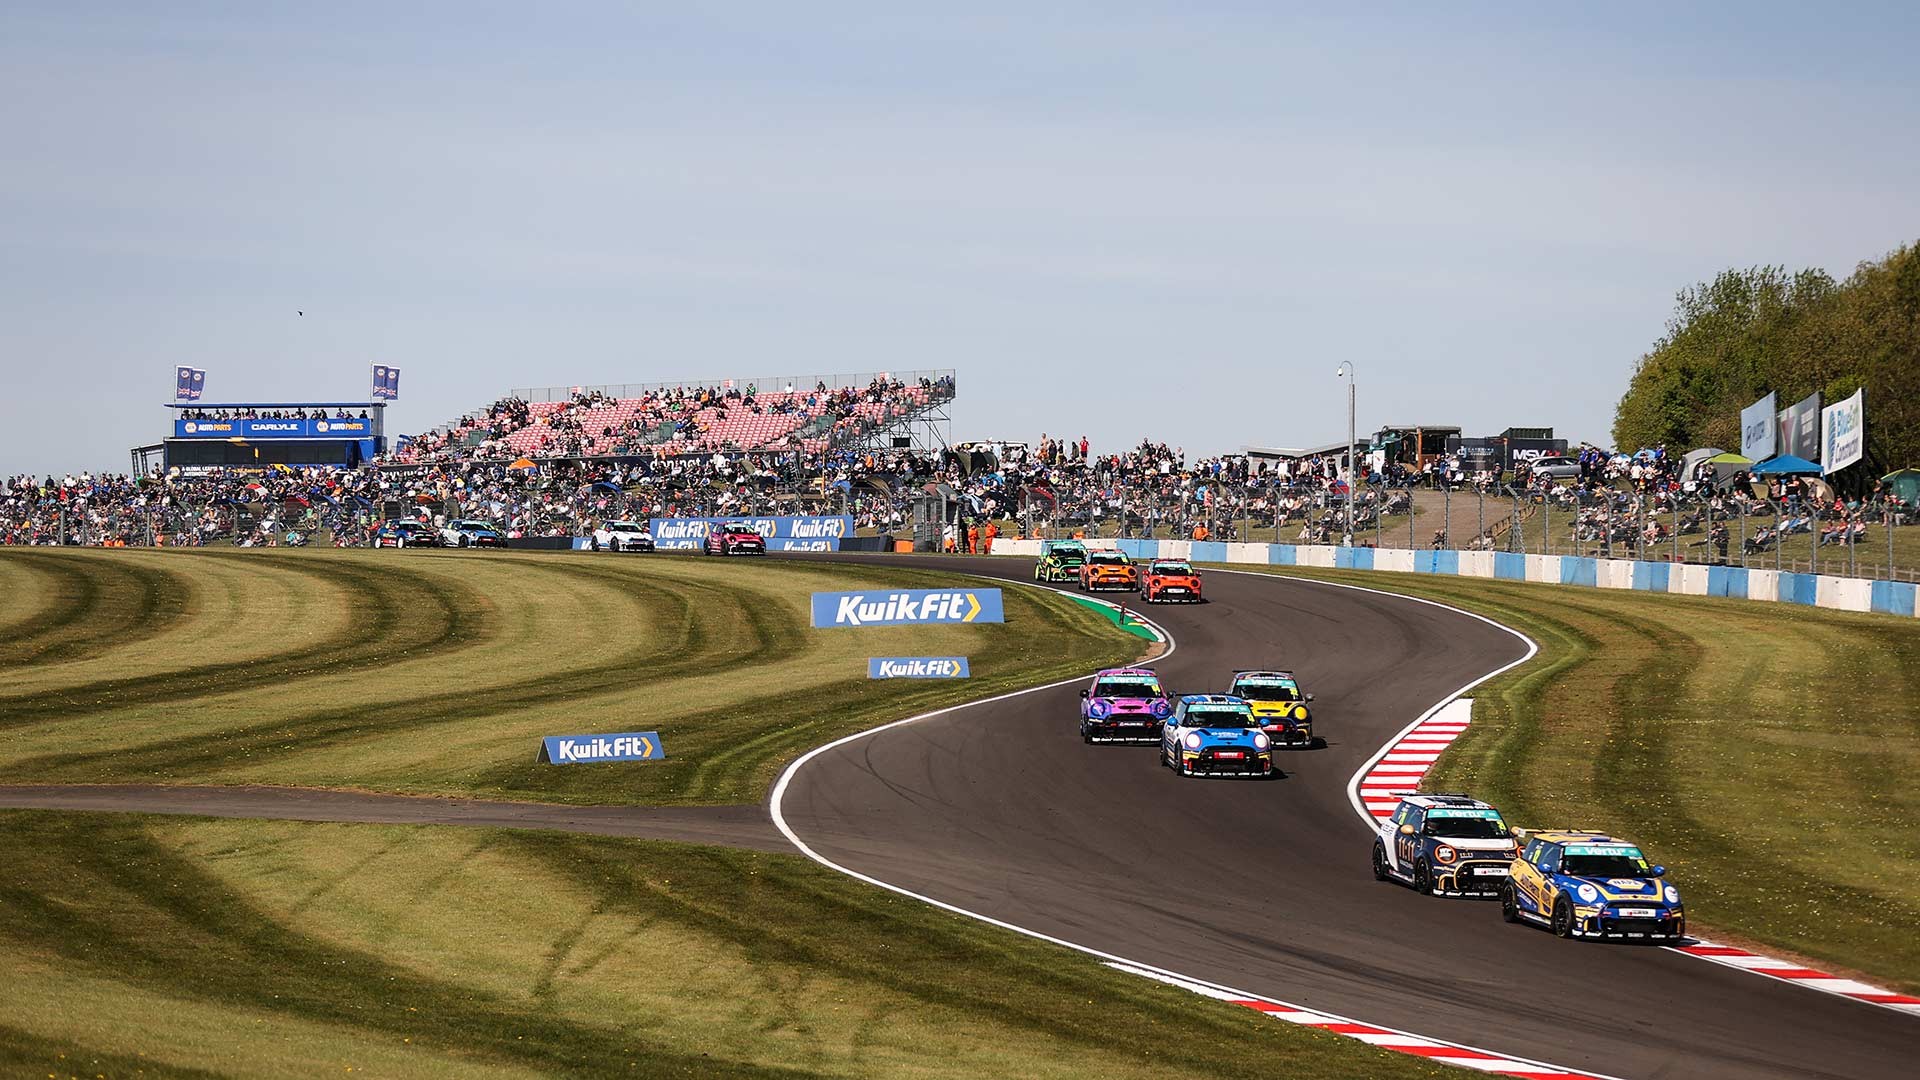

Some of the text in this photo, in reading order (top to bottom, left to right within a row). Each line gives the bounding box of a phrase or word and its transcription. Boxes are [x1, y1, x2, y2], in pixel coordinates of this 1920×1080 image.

[198, 423, 213, 431] AUTO
[213, 423, 232, 431] PARTS
[251, 423, 298, 431] CARLYLE
[330, 422, 345, 430] AUTO
[345, 422, 364, 430] PARTS
[657, 520, 704, 539] KwikFit
[790, 518, 840, 538] KwikFit
[835, 593, 964, 625] KwikFit
[879, 660, 952, 678] KwikFit
[559, 737, 642, 761] KwikFit
[1584, 847, 1622, 856] Vertu
